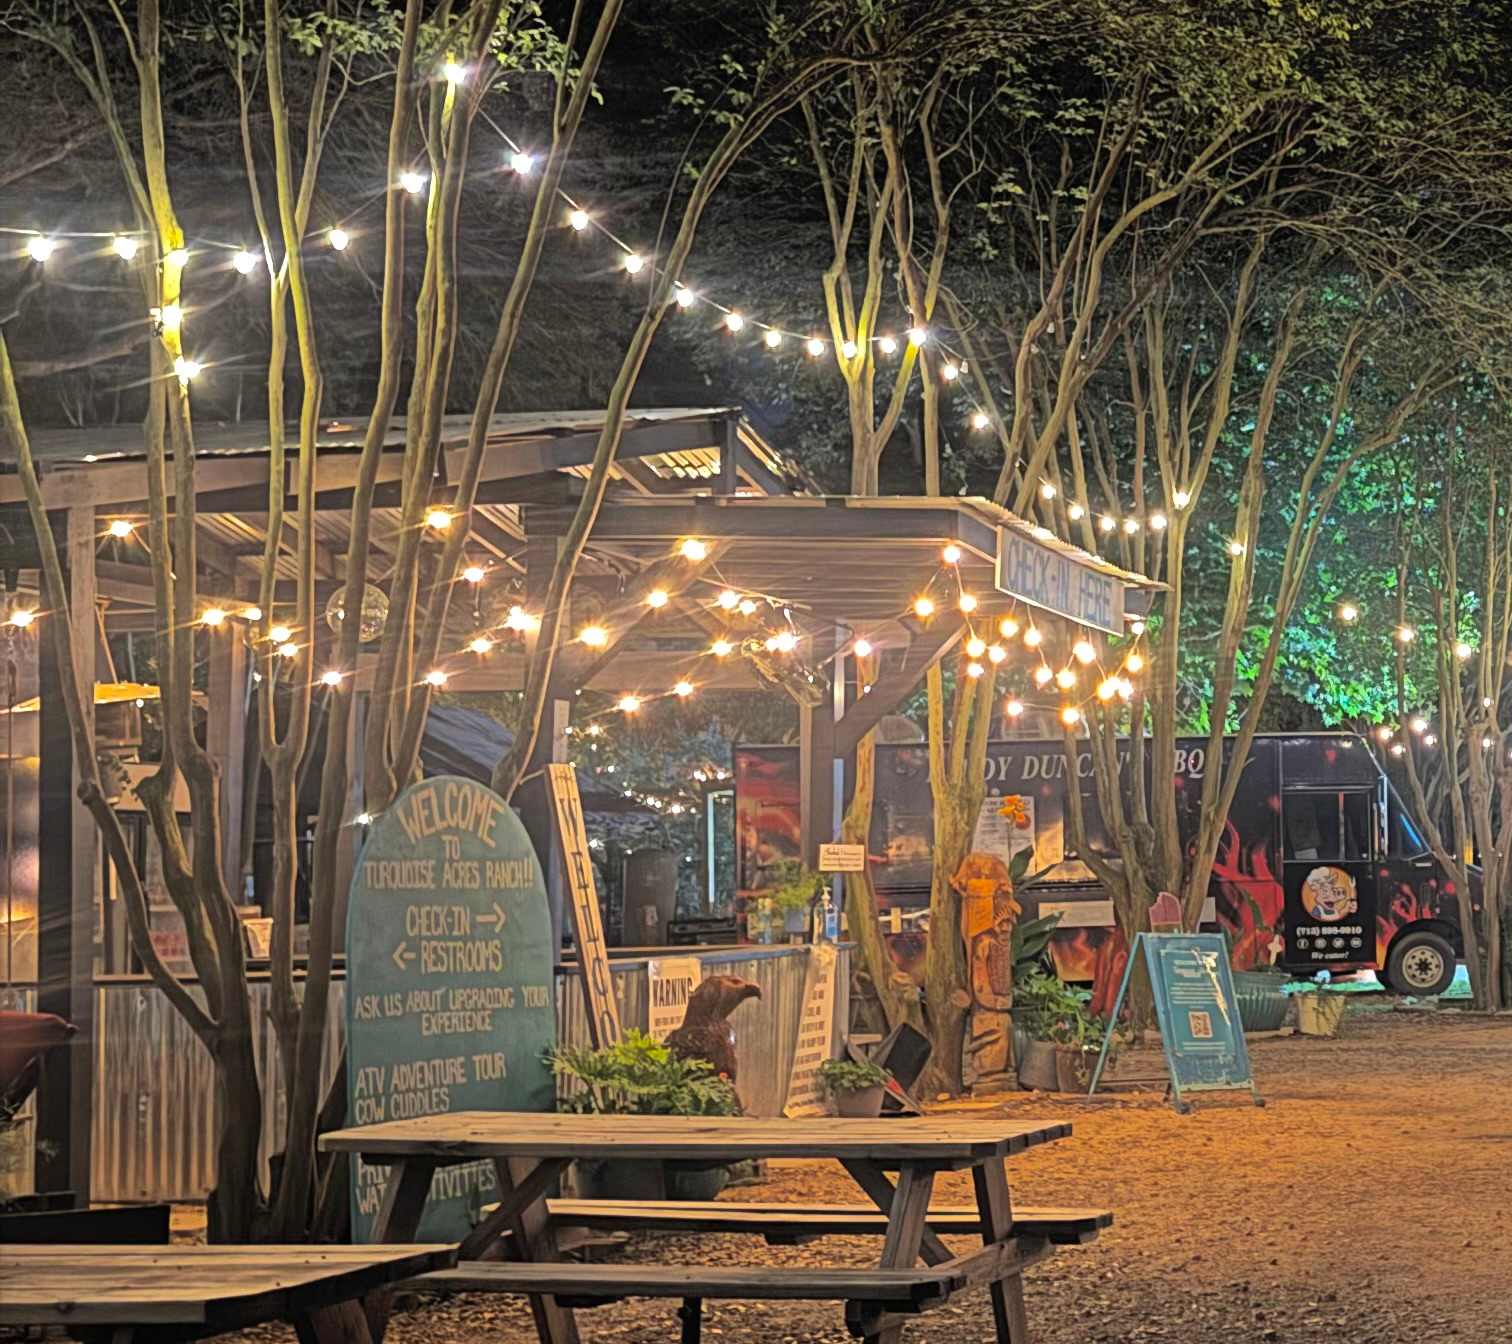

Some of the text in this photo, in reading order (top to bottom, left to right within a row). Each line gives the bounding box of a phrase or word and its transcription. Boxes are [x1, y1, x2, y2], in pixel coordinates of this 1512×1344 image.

[1007, 537, 1112, 628] CHECK-IN HERE
[396, 782, 504, 848] WELCOME
[441, 835, 461, 860] TO
[364, 858, 534, 889] TURQUOISE ACRES RANCH!!
[405, 905, 471, 936] CHECK-IN
[421, 940, 503, 974] RESTROOMS
[355, 985, 550, 1019] ASK US ABOUT UPGRADING YOUR
[421, 1010, 494, 1036] EXPERIENCE
[355, 1052, 507, 1097] ATV ADVENTURE TOUR
[355, 1087, 450, 1125] COW CUDDLES
